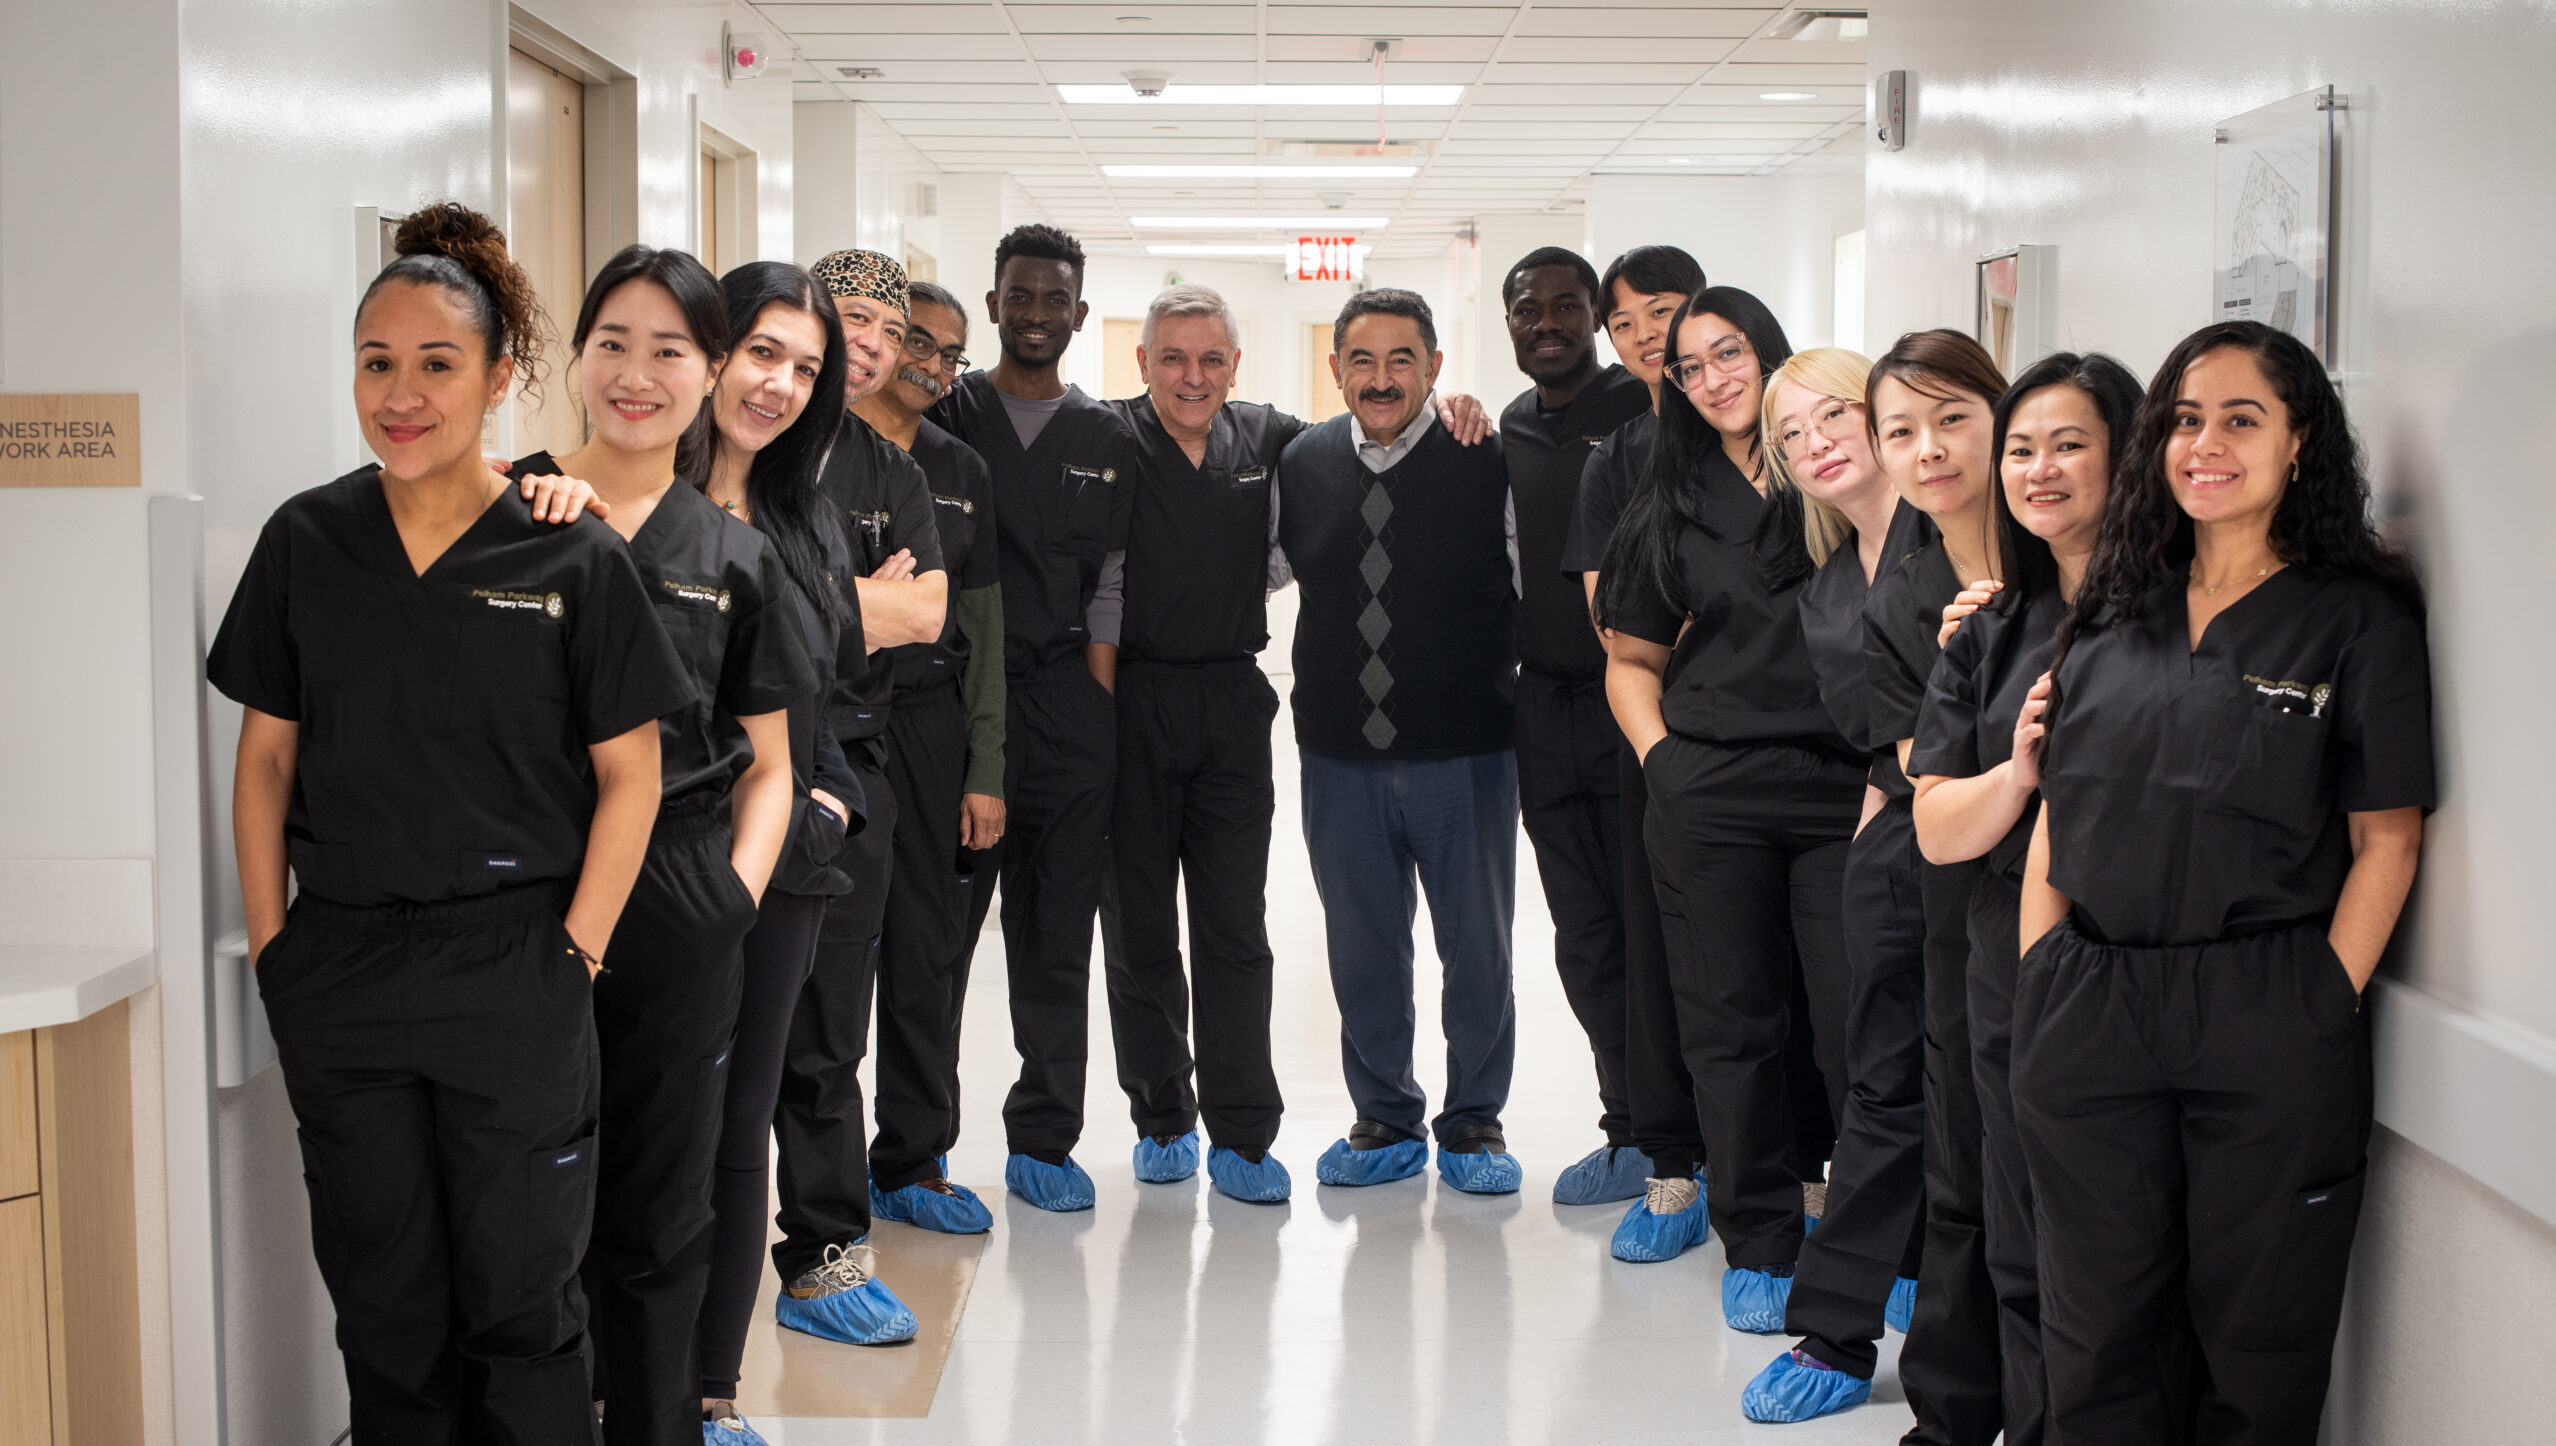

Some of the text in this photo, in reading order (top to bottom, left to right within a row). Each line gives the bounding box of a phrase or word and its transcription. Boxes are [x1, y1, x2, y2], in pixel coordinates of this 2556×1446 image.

[1298, 237, 1355, 280] EXIT
[57, 442, 116, 458] AREA
[664, 580, 693, 591] Pelham
[473, 589, 544, 604] Pelham Parkway
[677, 589, 704, 600] Surgery
[487, 597, 543, 609] Surgery Center
